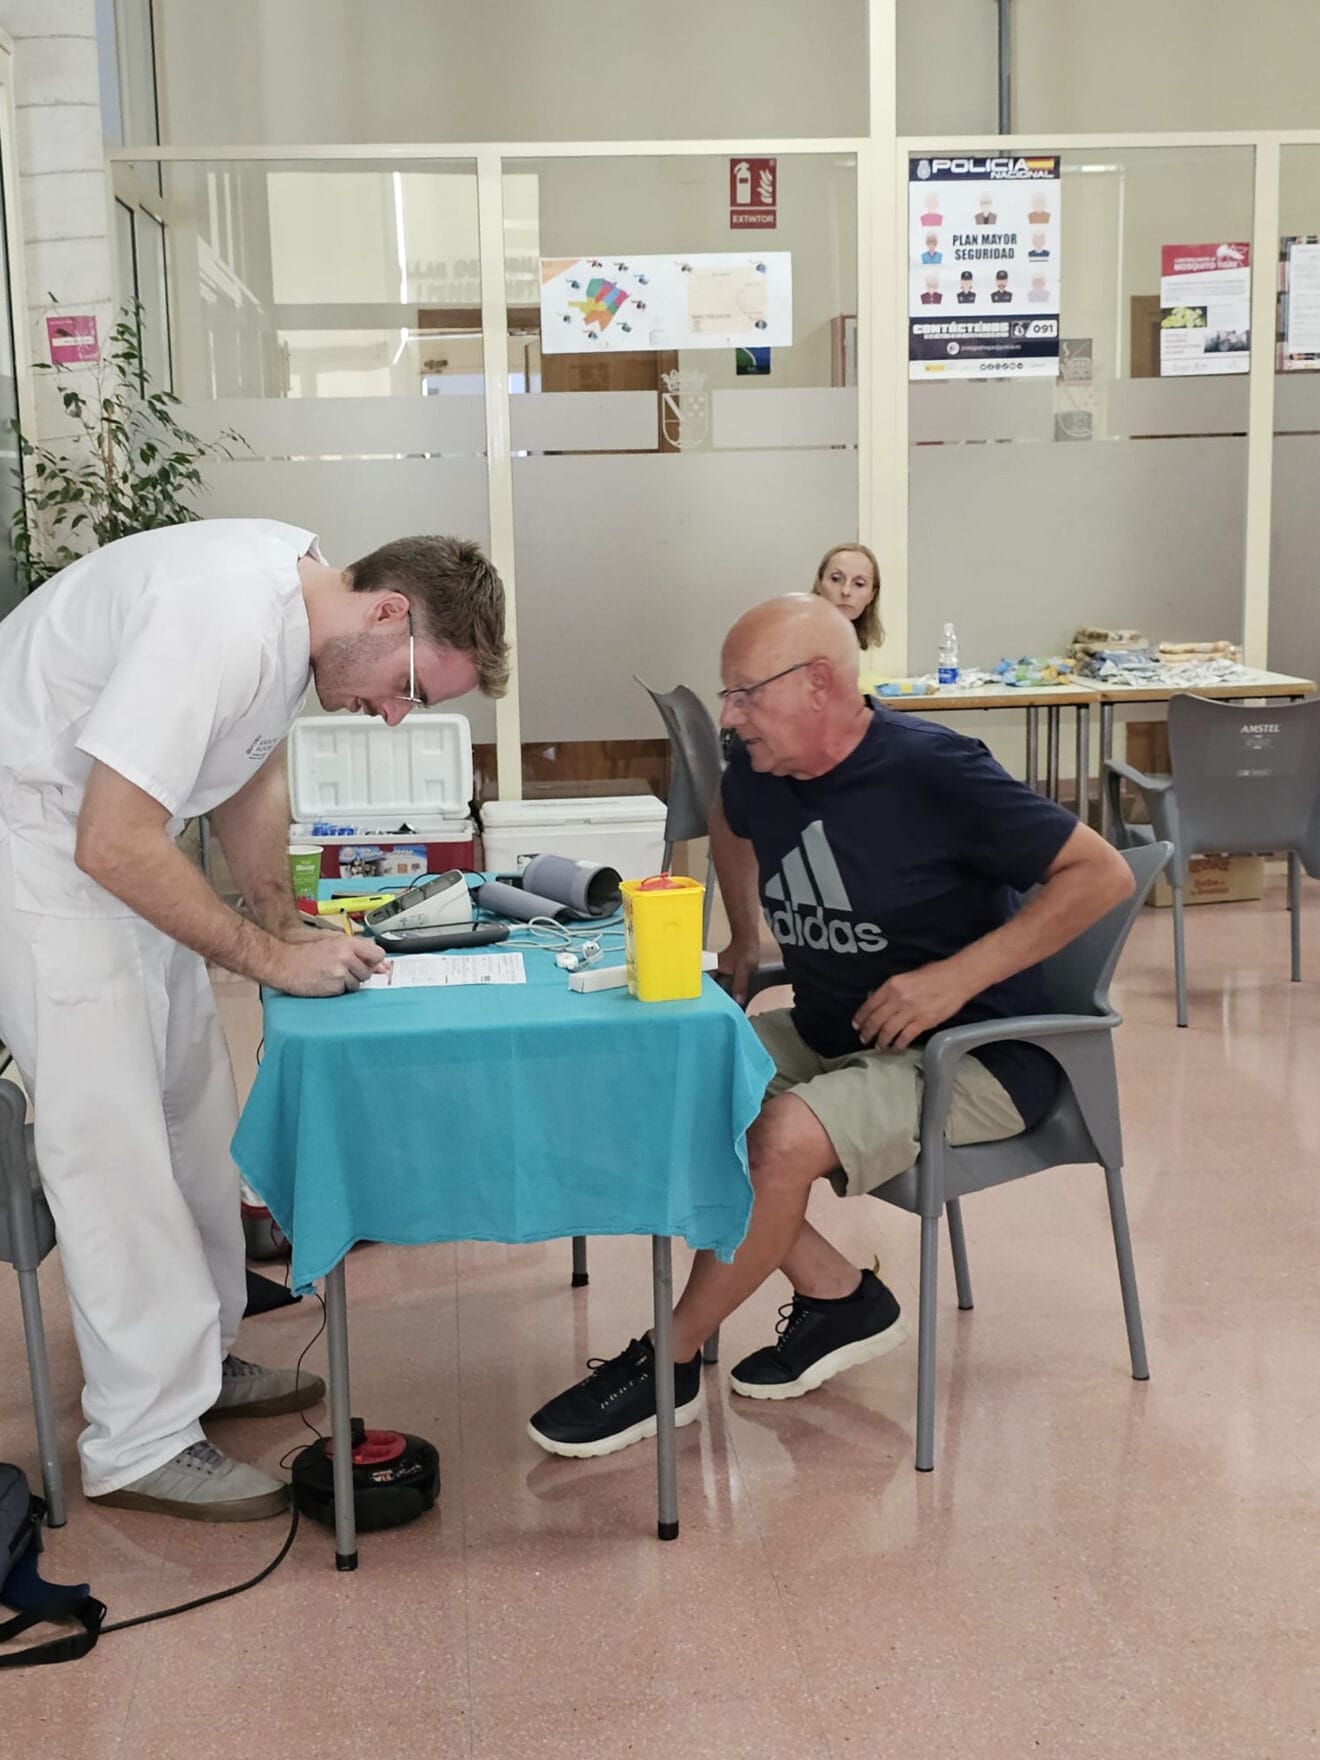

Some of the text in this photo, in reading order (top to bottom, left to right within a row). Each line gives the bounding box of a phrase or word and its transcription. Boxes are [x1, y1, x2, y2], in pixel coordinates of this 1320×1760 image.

[990, 170, 1055, 179] NACIONAL
[732, 215, 774, 224] EXTINTOR
[952, 233, 1018, 247] PLAN MAYOR
[954, 248, 1015, 261] SEGURIDAD
[1033, 324, 1054, 334] 091
[1240, 724, 1281, 734] AMSTEL
